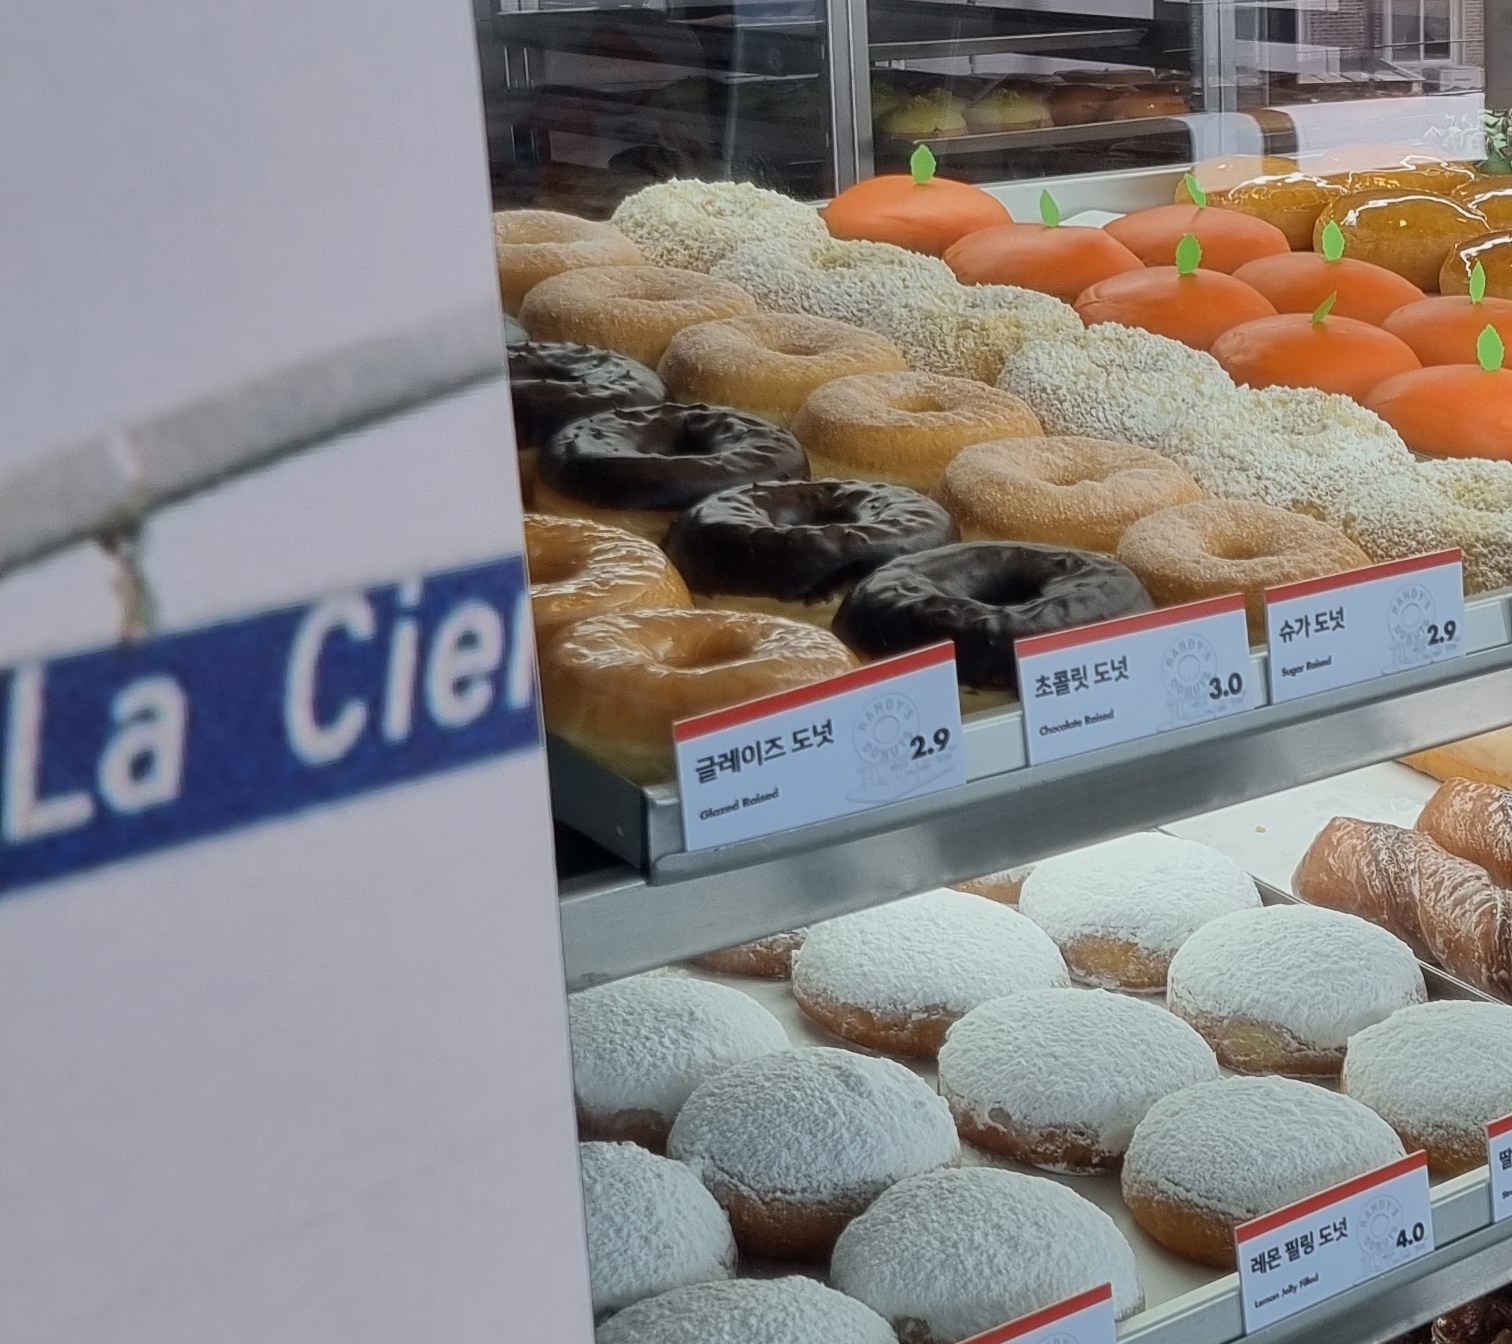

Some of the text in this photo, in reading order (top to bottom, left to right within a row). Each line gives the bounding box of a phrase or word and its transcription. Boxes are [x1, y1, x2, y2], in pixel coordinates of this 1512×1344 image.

[1278, 605, 1346, 644] 슈가 도넛
[1426, 619, 1457, 647] 2.9
[1034, 654, 1130, 699] 초콜릿 도넛
[1281, 654, 1332, 678] Sugar Raised
[1207, 671, 1243, 701] 3.0
[2, 578, 534, 843] La Cie
[1039, 708, 1115, 737] Chocolate Raised
[695, 718, 835, 785] 글레이즈 도넛
[909, 726, 952, 761] 2.9
[699, 787, 780, 821] Glazed Raised
[1250, 1216, 1349, 1275] 레몬 필링 도넛
[1395, 1221, 1424, 1249] 4.0
[1254, 1271, 1320, 1309] Lemon Jelly Filled
